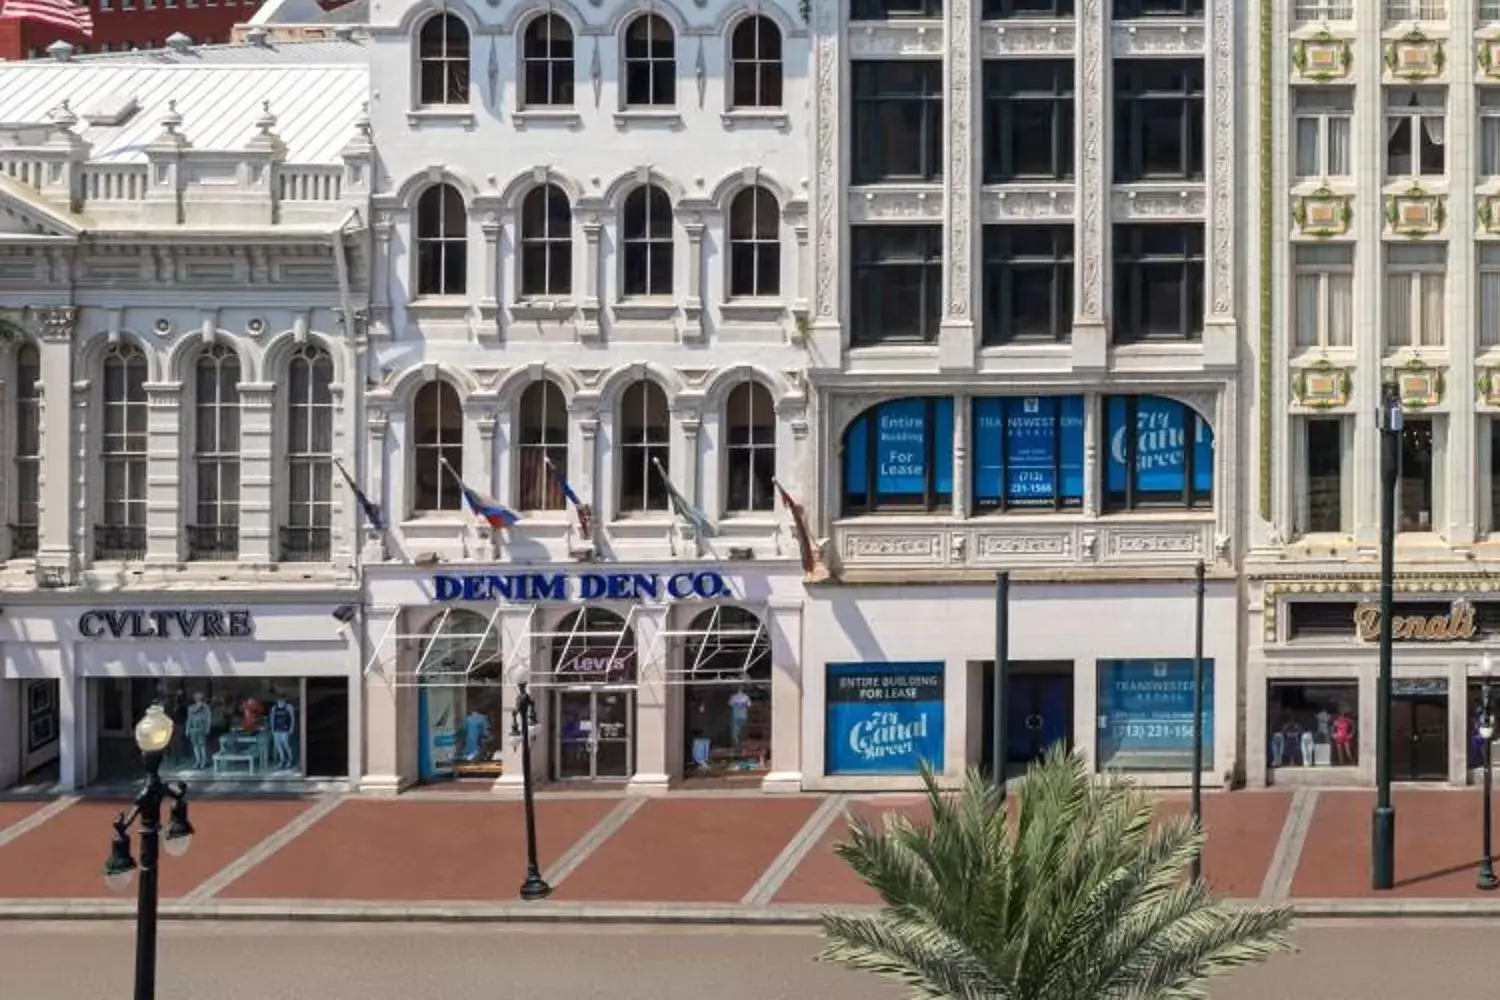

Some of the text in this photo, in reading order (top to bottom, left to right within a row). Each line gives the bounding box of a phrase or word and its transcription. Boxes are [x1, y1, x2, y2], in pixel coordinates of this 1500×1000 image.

[881, 415, 923, 429] Entire
[889, 451, 914, 463] For
[881, 464, 923, 476] Lease
[432, 572, 732, 601] DENIM DEN CO.
[840, 676, 938, 687] ENTIRE BUILDING
[860, 687, 918, 699] FOR LEASE
